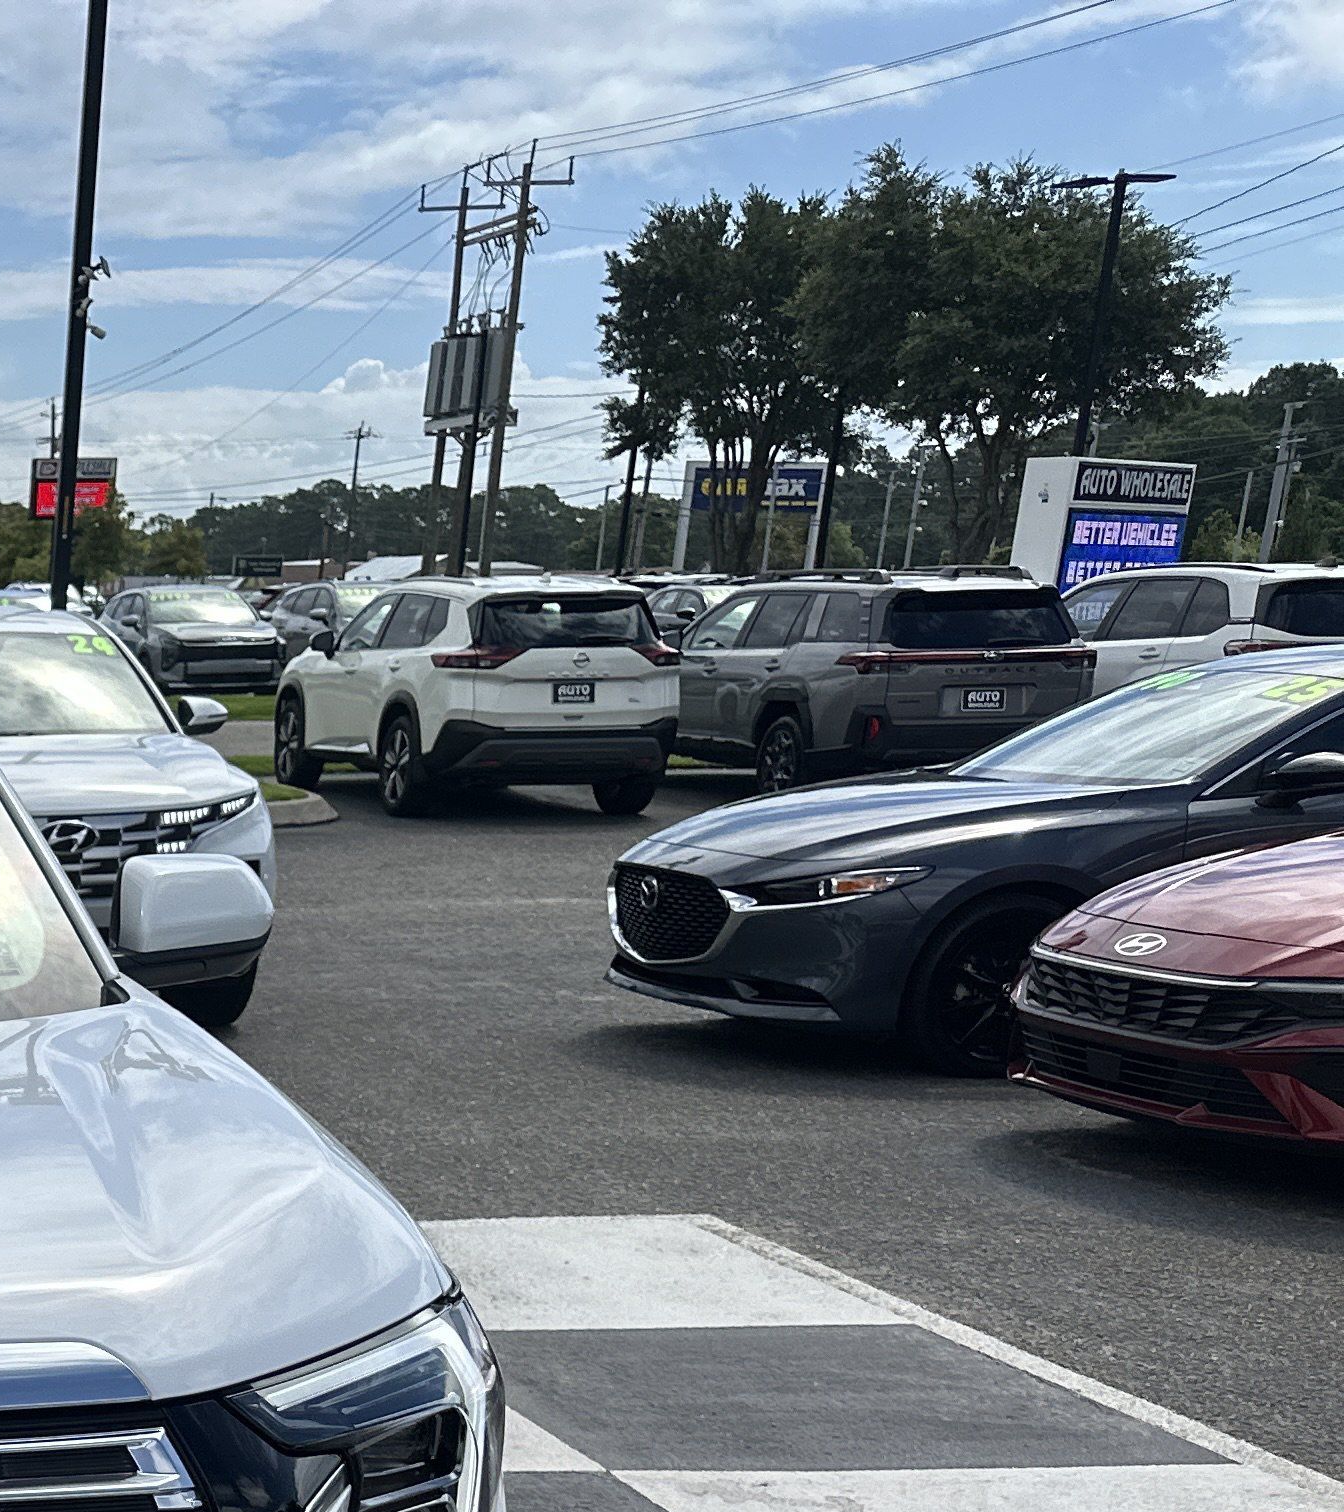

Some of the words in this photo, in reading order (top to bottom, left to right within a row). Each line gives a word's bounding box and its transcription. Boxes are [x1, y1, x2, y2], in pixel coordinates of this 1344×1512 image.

[1080, 468, 1118, 496] AUTO
[1120, 470, 1191, 500] WHOLESALE
[1072, 520, 1121, 545] BETTER
[1120, 522, 1178, 546] VEHICLES
[558, 684, 590, 696] AUTO
[968, 691, 1000, 702] AUTO
[1262, 675, 1344, 703] 25
